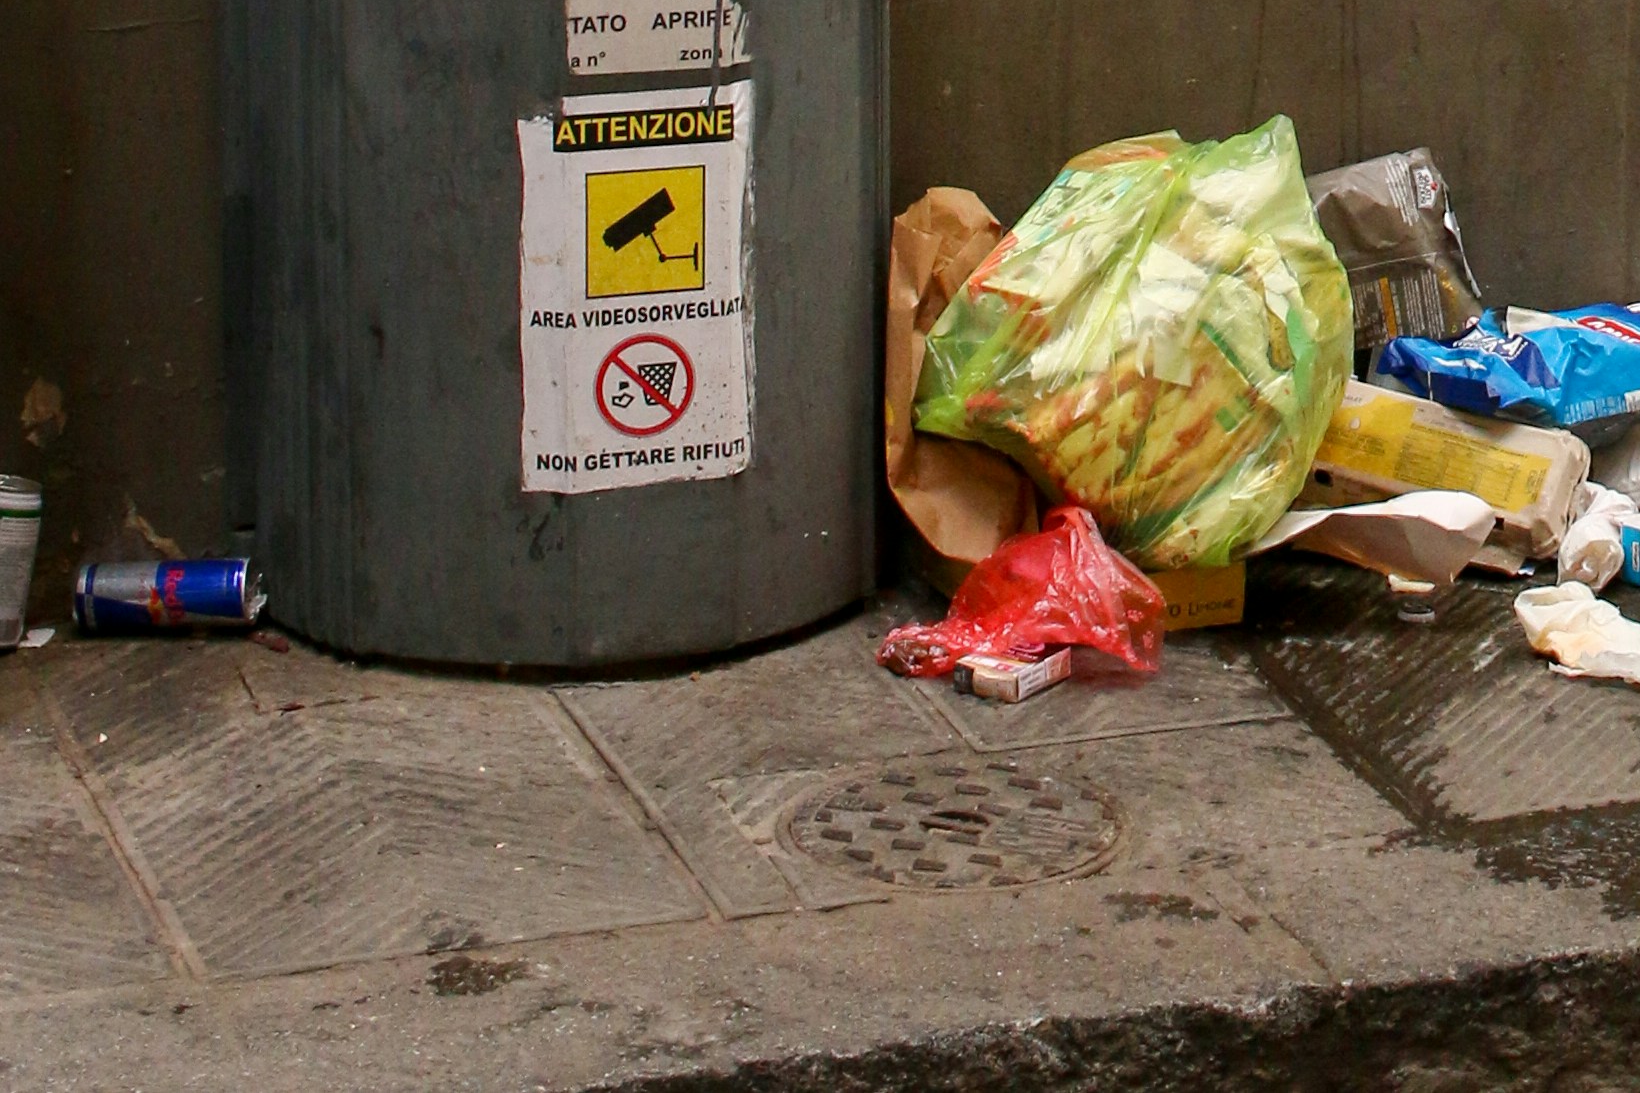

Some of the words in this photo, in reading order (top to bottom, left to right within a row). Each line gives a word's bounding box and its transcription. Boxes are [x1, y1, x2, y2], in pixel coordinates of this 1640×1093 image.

[555, 109, 733, 145] ATTENZIONE
[530, 310, 577, 329] AREA
[536, 454, 578, 472] NON
[584, 447, 675, 471] GETTARE
[683, 437, 745, 462] RIFIUTI
